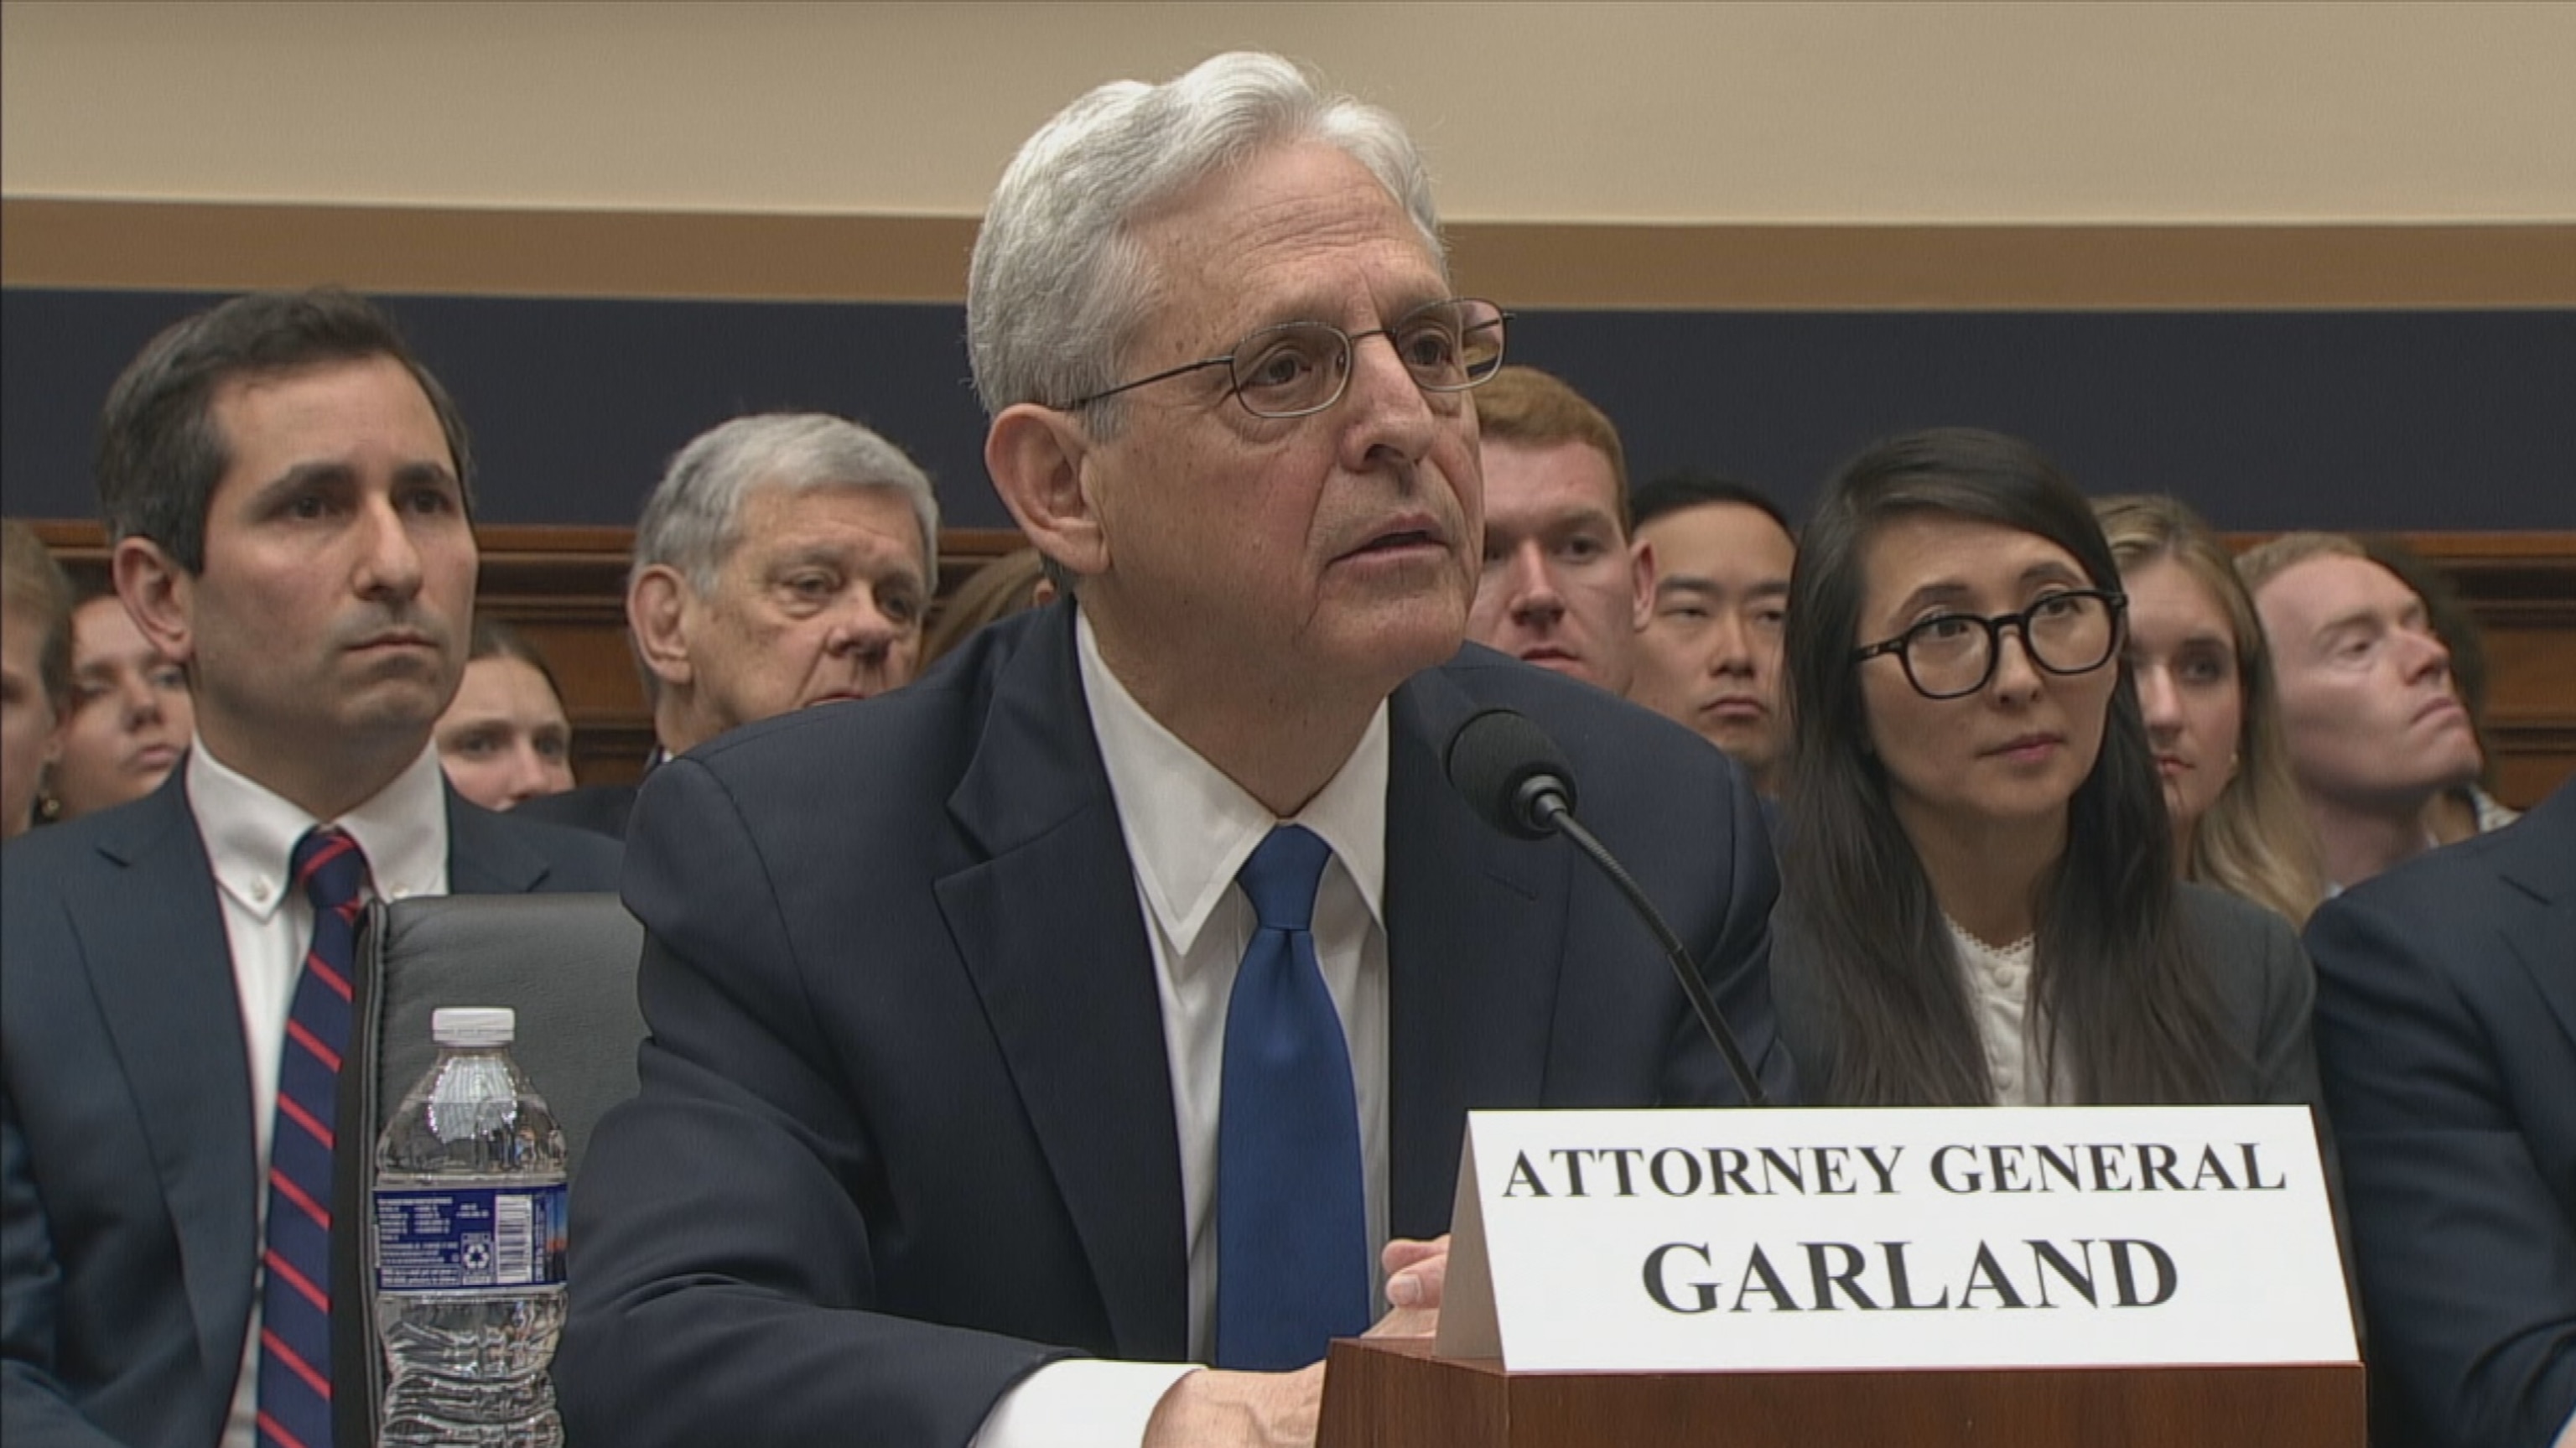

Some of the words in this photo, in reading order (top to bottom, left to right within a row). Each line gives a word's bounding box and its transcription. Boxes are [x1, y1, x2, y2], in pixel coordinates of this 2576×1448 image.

[1504, 1146, 1906, 1196] ATTORNEY
[1930, 1143, 2287, 1193] GENERAL
[1641, 1238, 2179, 1314] GARLAND
